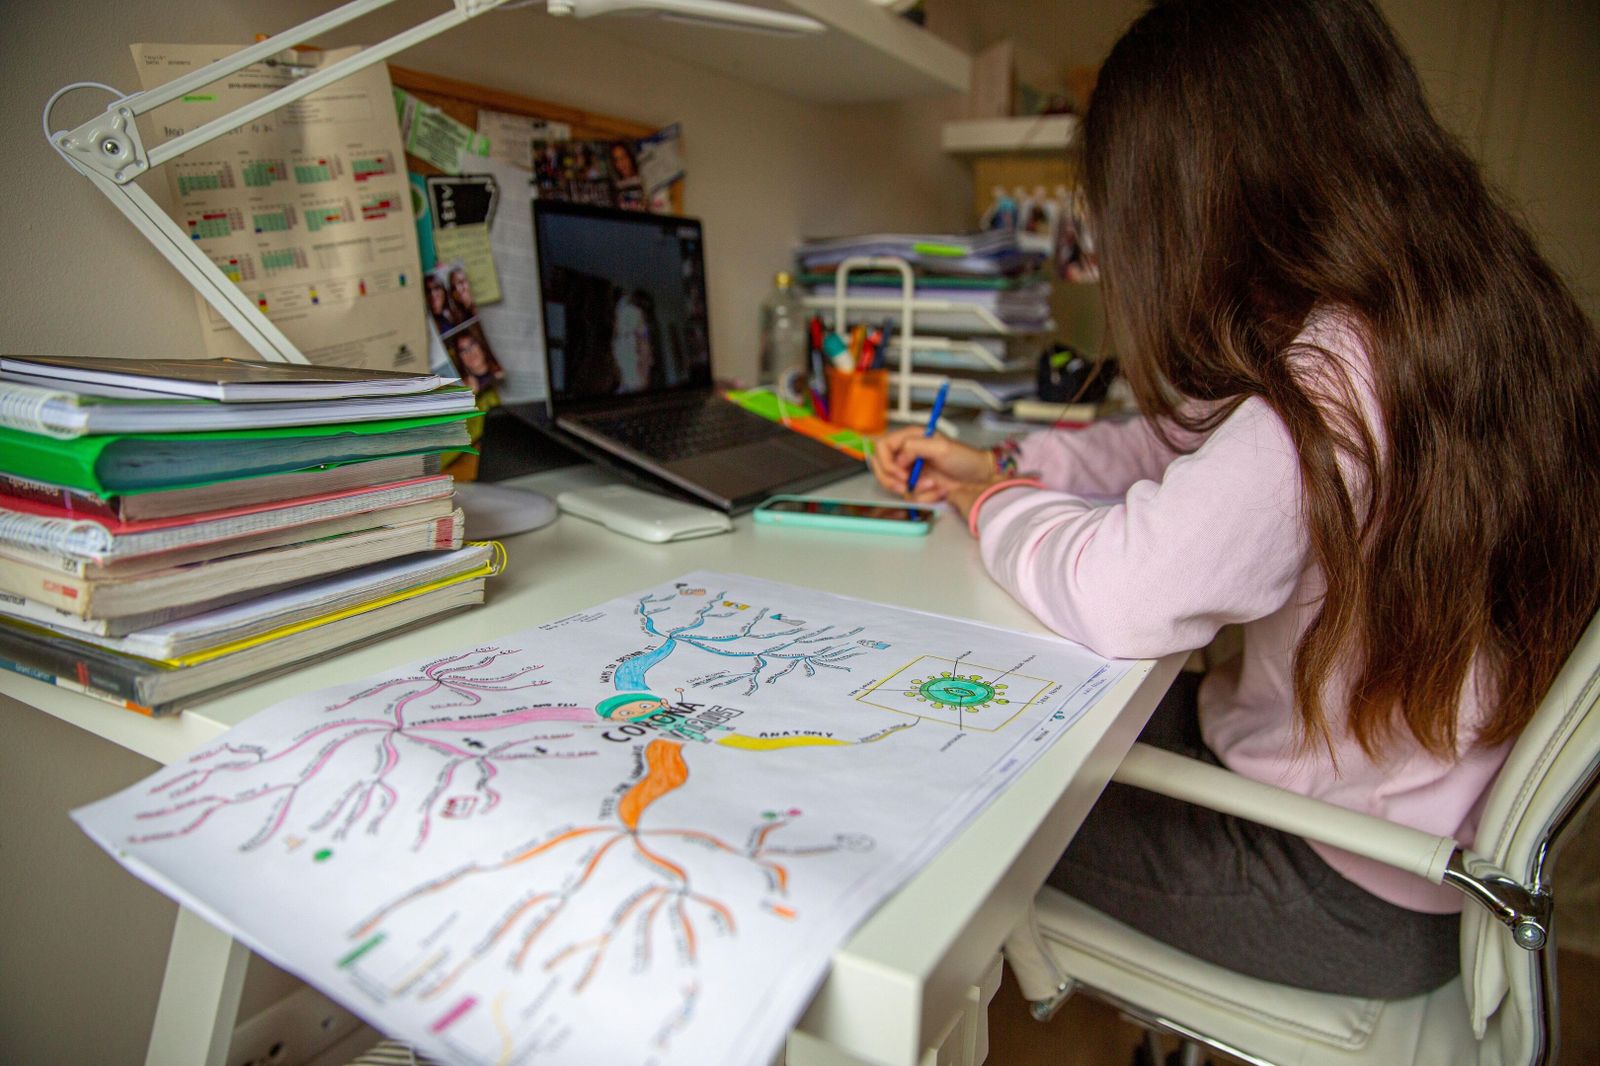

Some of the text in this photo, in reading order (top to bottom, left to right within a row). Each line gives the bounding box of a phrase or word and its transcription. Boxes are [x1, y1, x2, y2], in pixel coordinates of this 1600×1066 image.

[601, 701, 705, 742] CORONA
[650, 704, 745, 742] VIRUS
[758, 730, 834, 738] ANATOMY
